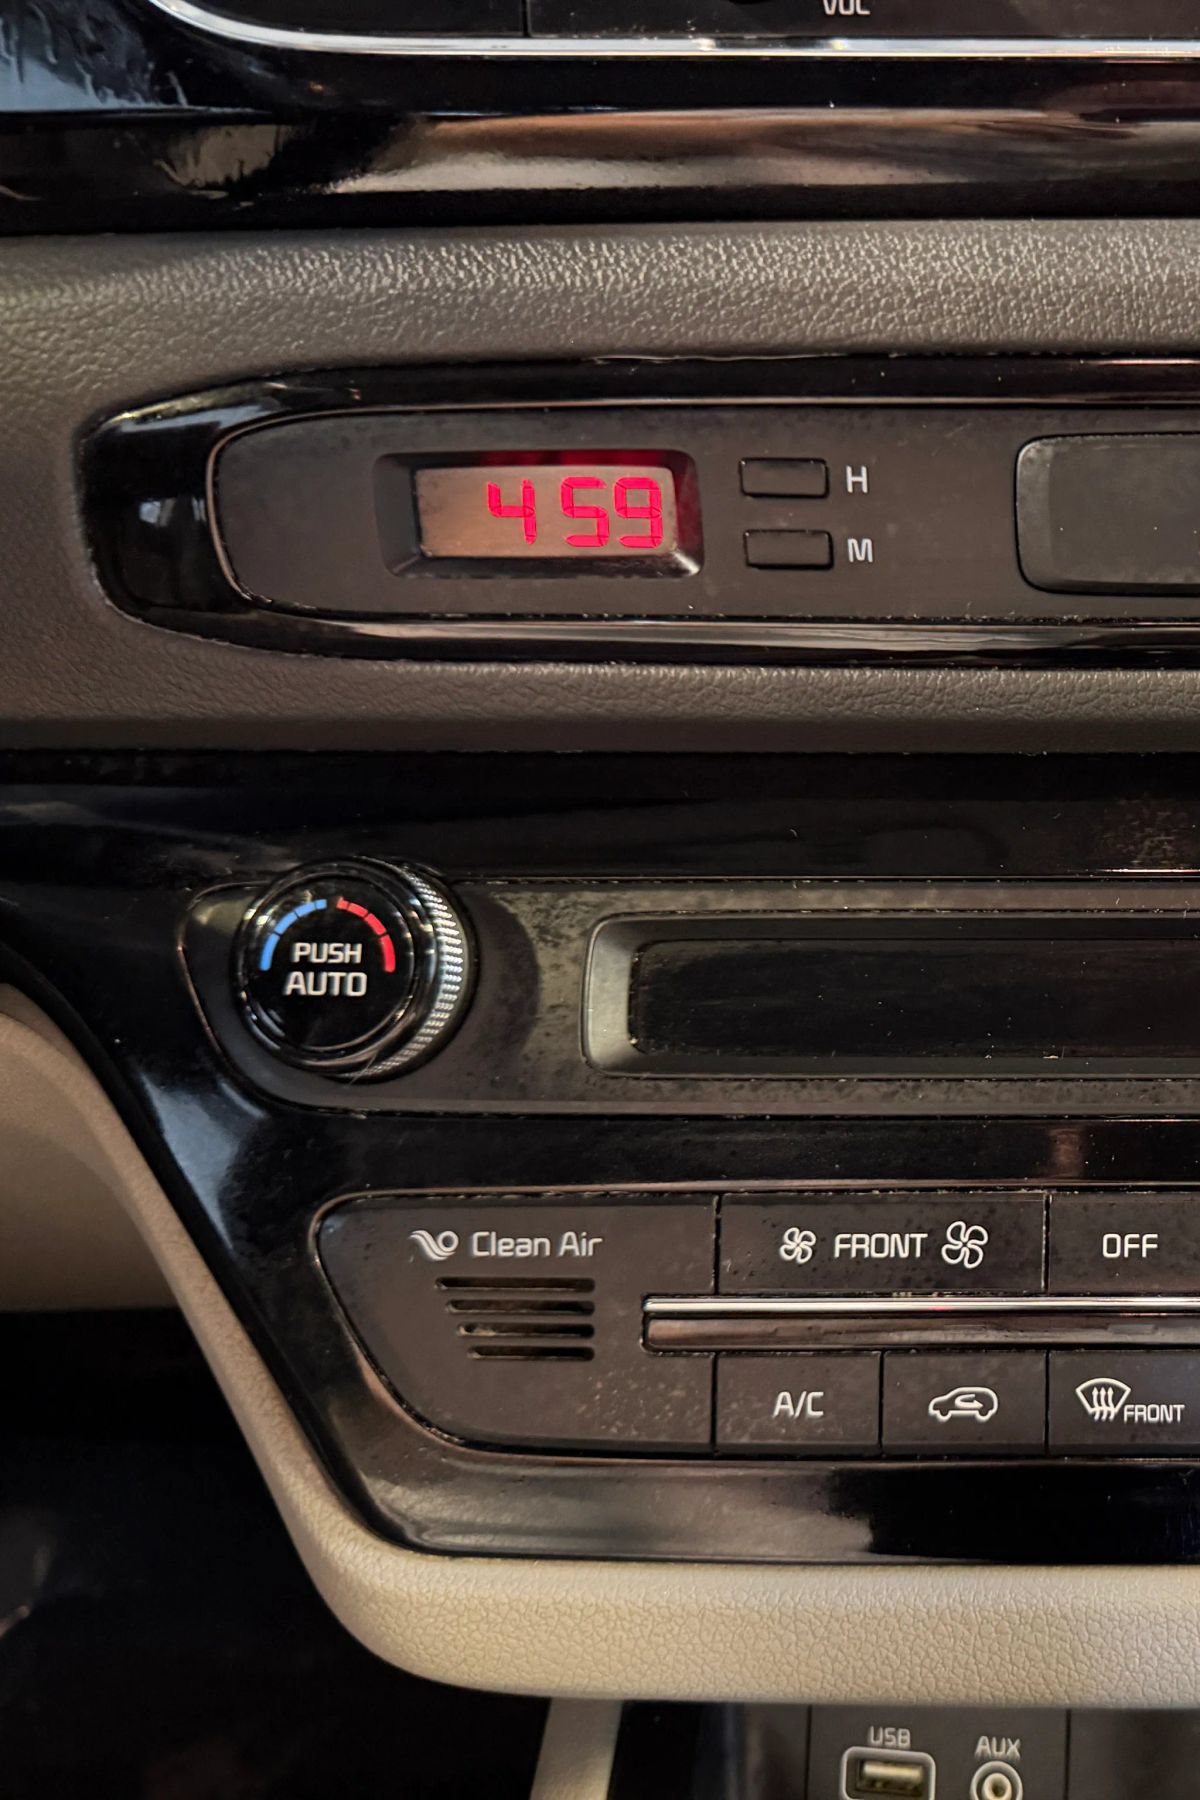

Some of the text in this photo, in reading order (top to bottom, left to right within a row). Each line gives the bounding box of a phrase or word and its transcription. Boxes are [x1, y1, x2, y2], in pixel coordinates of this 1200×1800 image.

[823, 0, 871, 15] VOL
[846, 465, 869, 494] H
[847, 538, 873, 563] M
[293, 942, 363, 963] PUSH
[285, 971, 368, 997] AUTO
[472, 1231, 603, 1258] Clean Air
[834, 1233, 928, 1259] FRONT
[1102, 1233, 1159, 1258] OFF
[773, 1391, 824, 1418] A/C
[1123, 1404, 1185, 1424] FRONT
[868, 1726, 911, 1749] USB
[975, 1735, 1021, 1759] AUX
